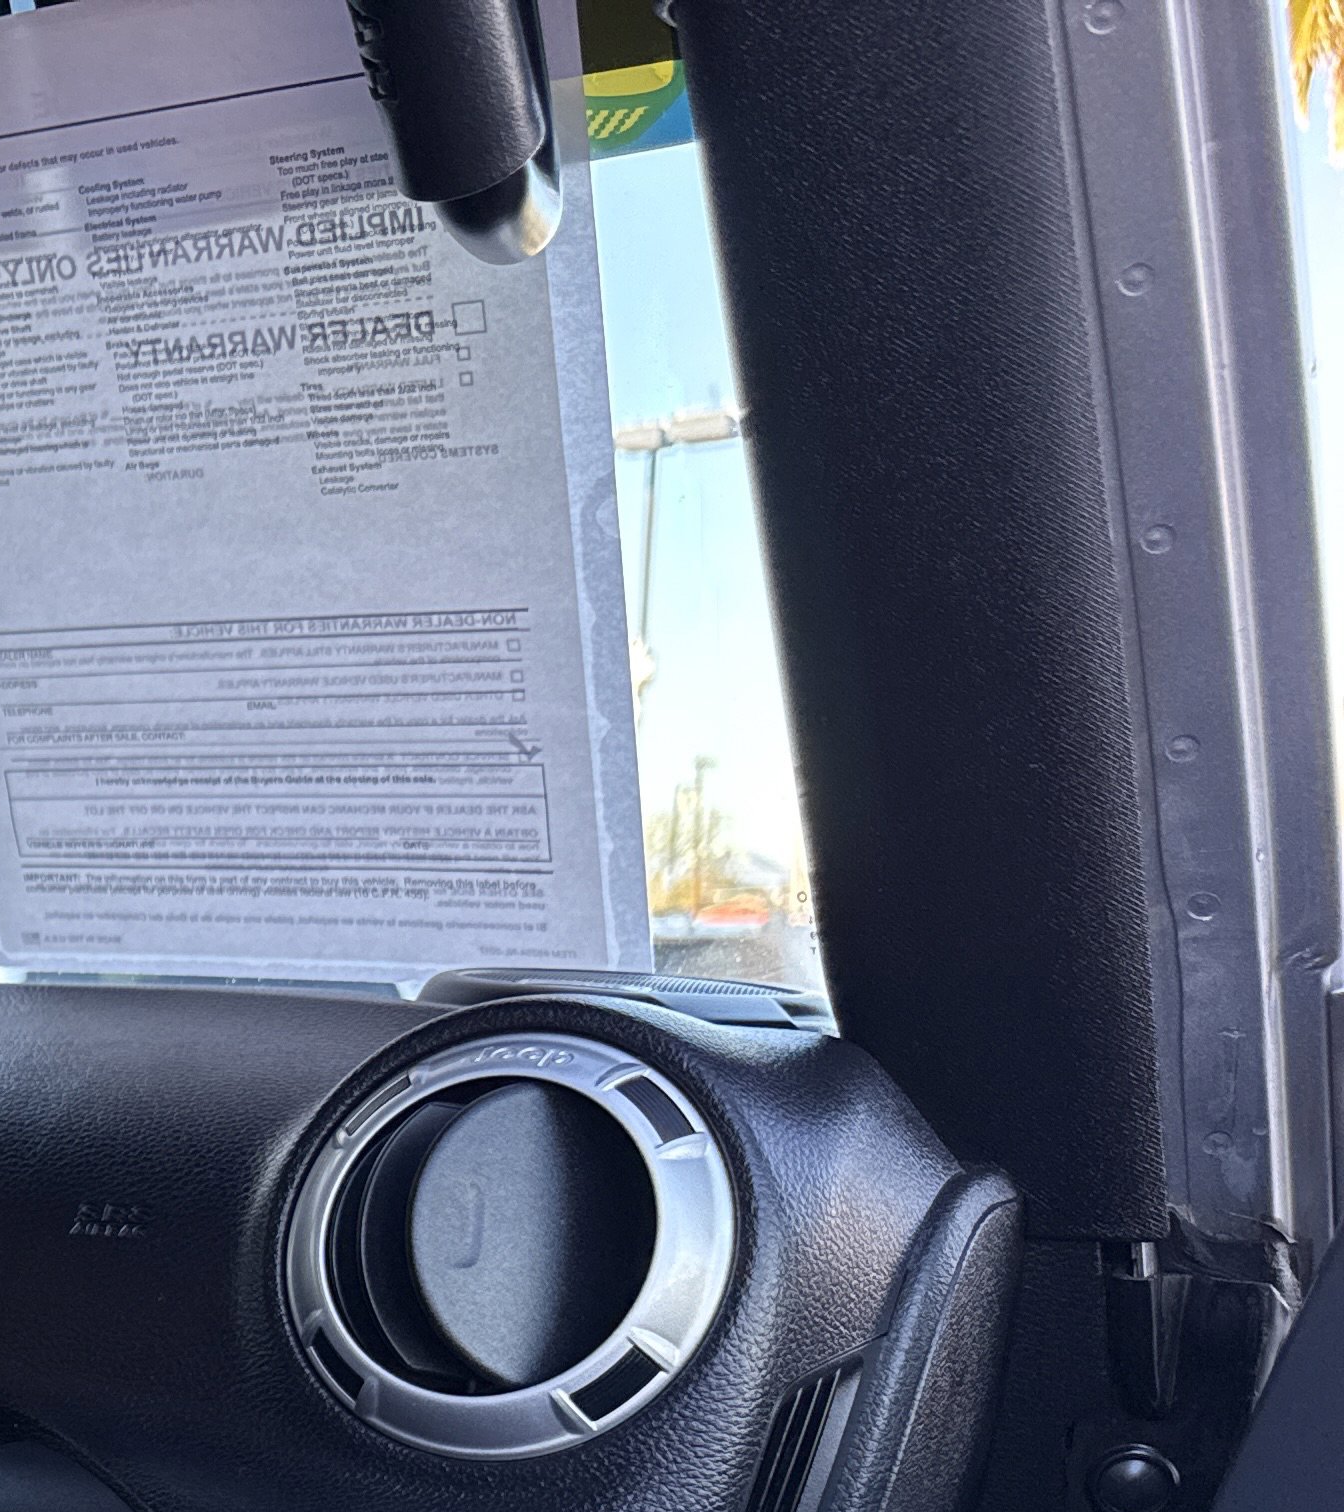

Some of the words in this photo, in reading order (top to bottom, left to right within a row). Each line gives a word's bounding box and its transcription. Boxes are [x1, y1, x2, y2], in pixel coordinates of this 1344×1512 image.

[310, 146, 344, 159] System
[340, 157, 357, 167] play
[302, 188, 319, 198] play
